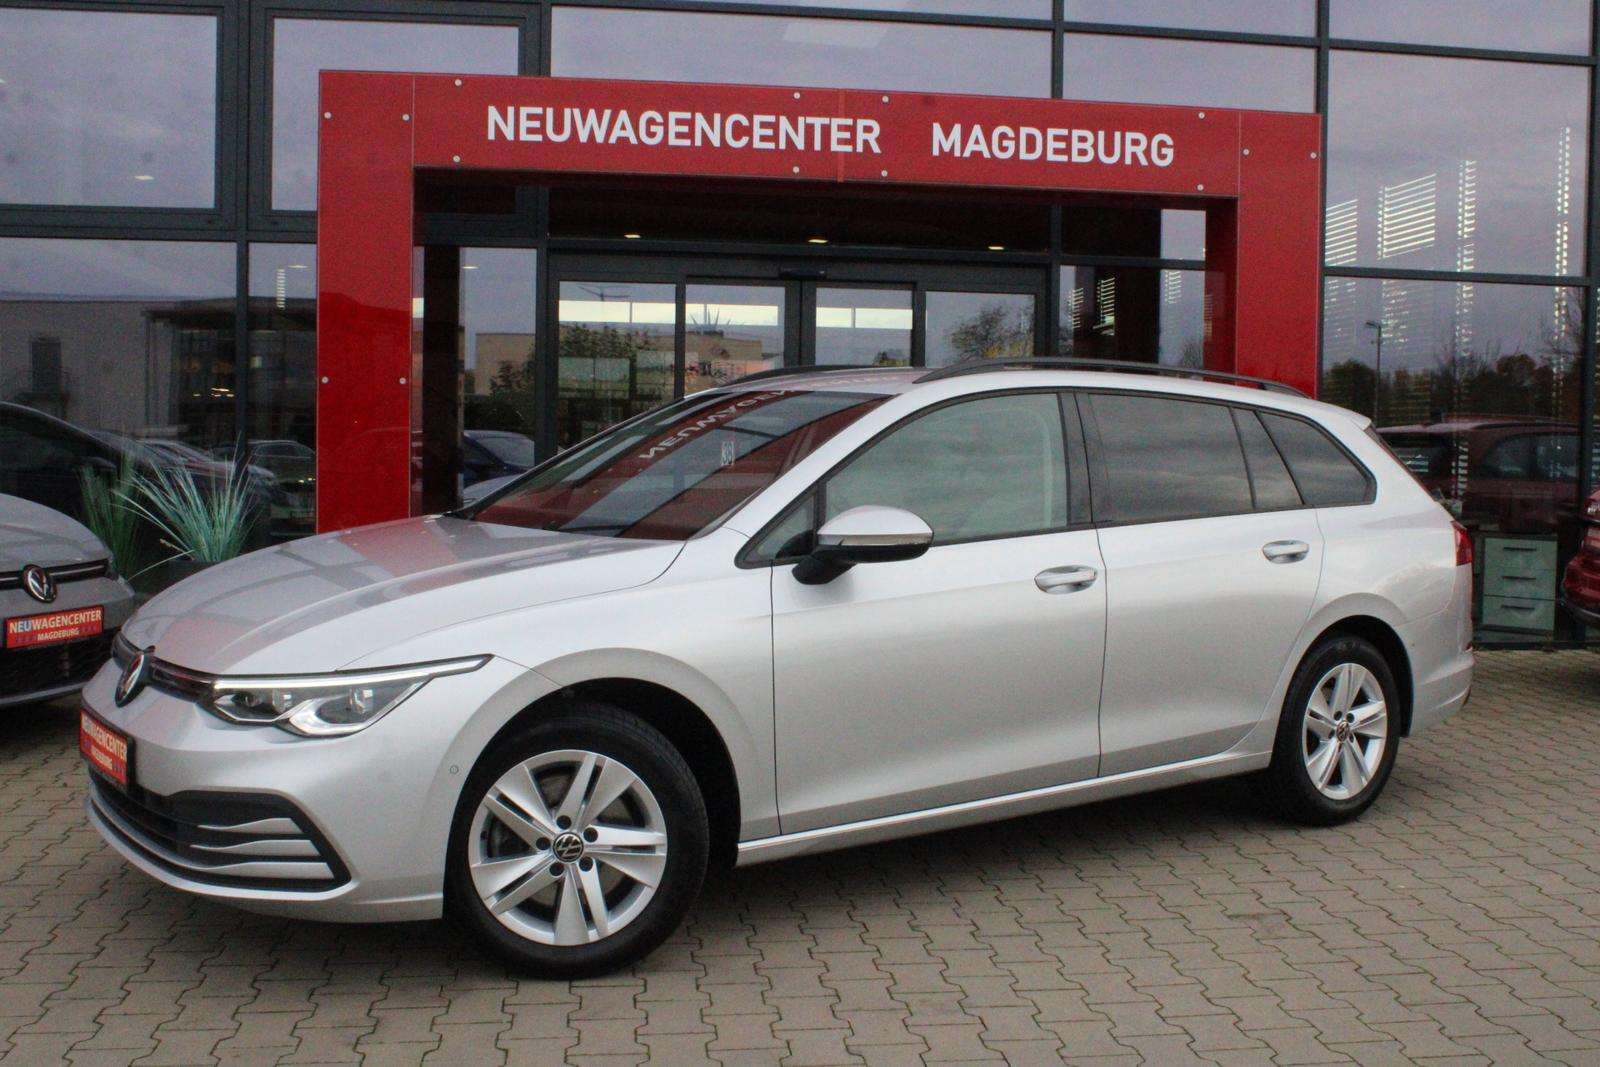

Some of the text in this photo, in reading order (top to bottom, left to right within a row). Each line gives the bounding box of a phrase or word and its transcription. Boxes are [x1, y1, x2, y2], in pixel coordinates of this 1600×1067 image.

[486, 105, 1175, 167] NEUWAGENCENTER MAGDEBURG
[9, 609, 102, 634] NEUWAGENCENTER
[37, 627, 80, 641] MAGDEBURG
